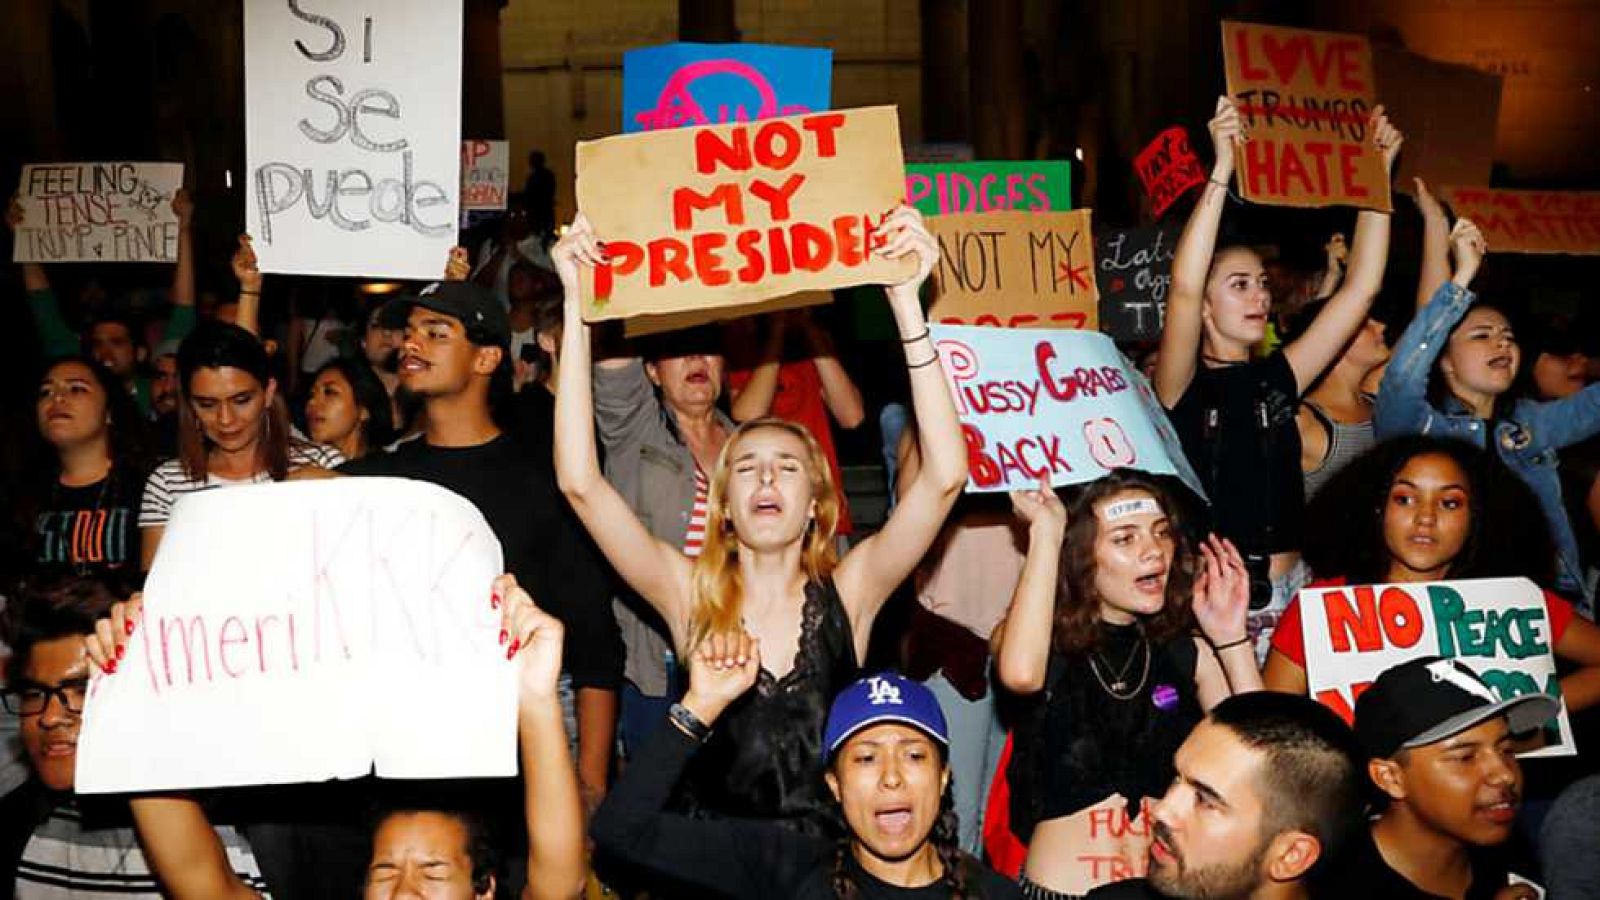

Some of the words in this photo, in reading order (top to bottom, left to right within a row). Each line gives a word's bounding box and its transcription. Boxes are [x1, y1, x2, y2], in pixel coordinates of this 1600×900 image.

[299, 75, 408, 152] Se
[1236, 90, 1367, 142] TRUMPS
[695, 113, 845, 175] NOT
[1245, 139, 1369, 197] HATE
[28, 165, 138, 196] FEELING
[37, 192, 129, 226] TENSE
[255, 150, 453, 246] puede
[673, 174, 806, 230] MY
[938, 231, 1006, 293] NOT
[1322, 586, 1425, 653] NO
[1427, 585, 1550, 659] PEACE
[867, 676, 904, 705] LA
